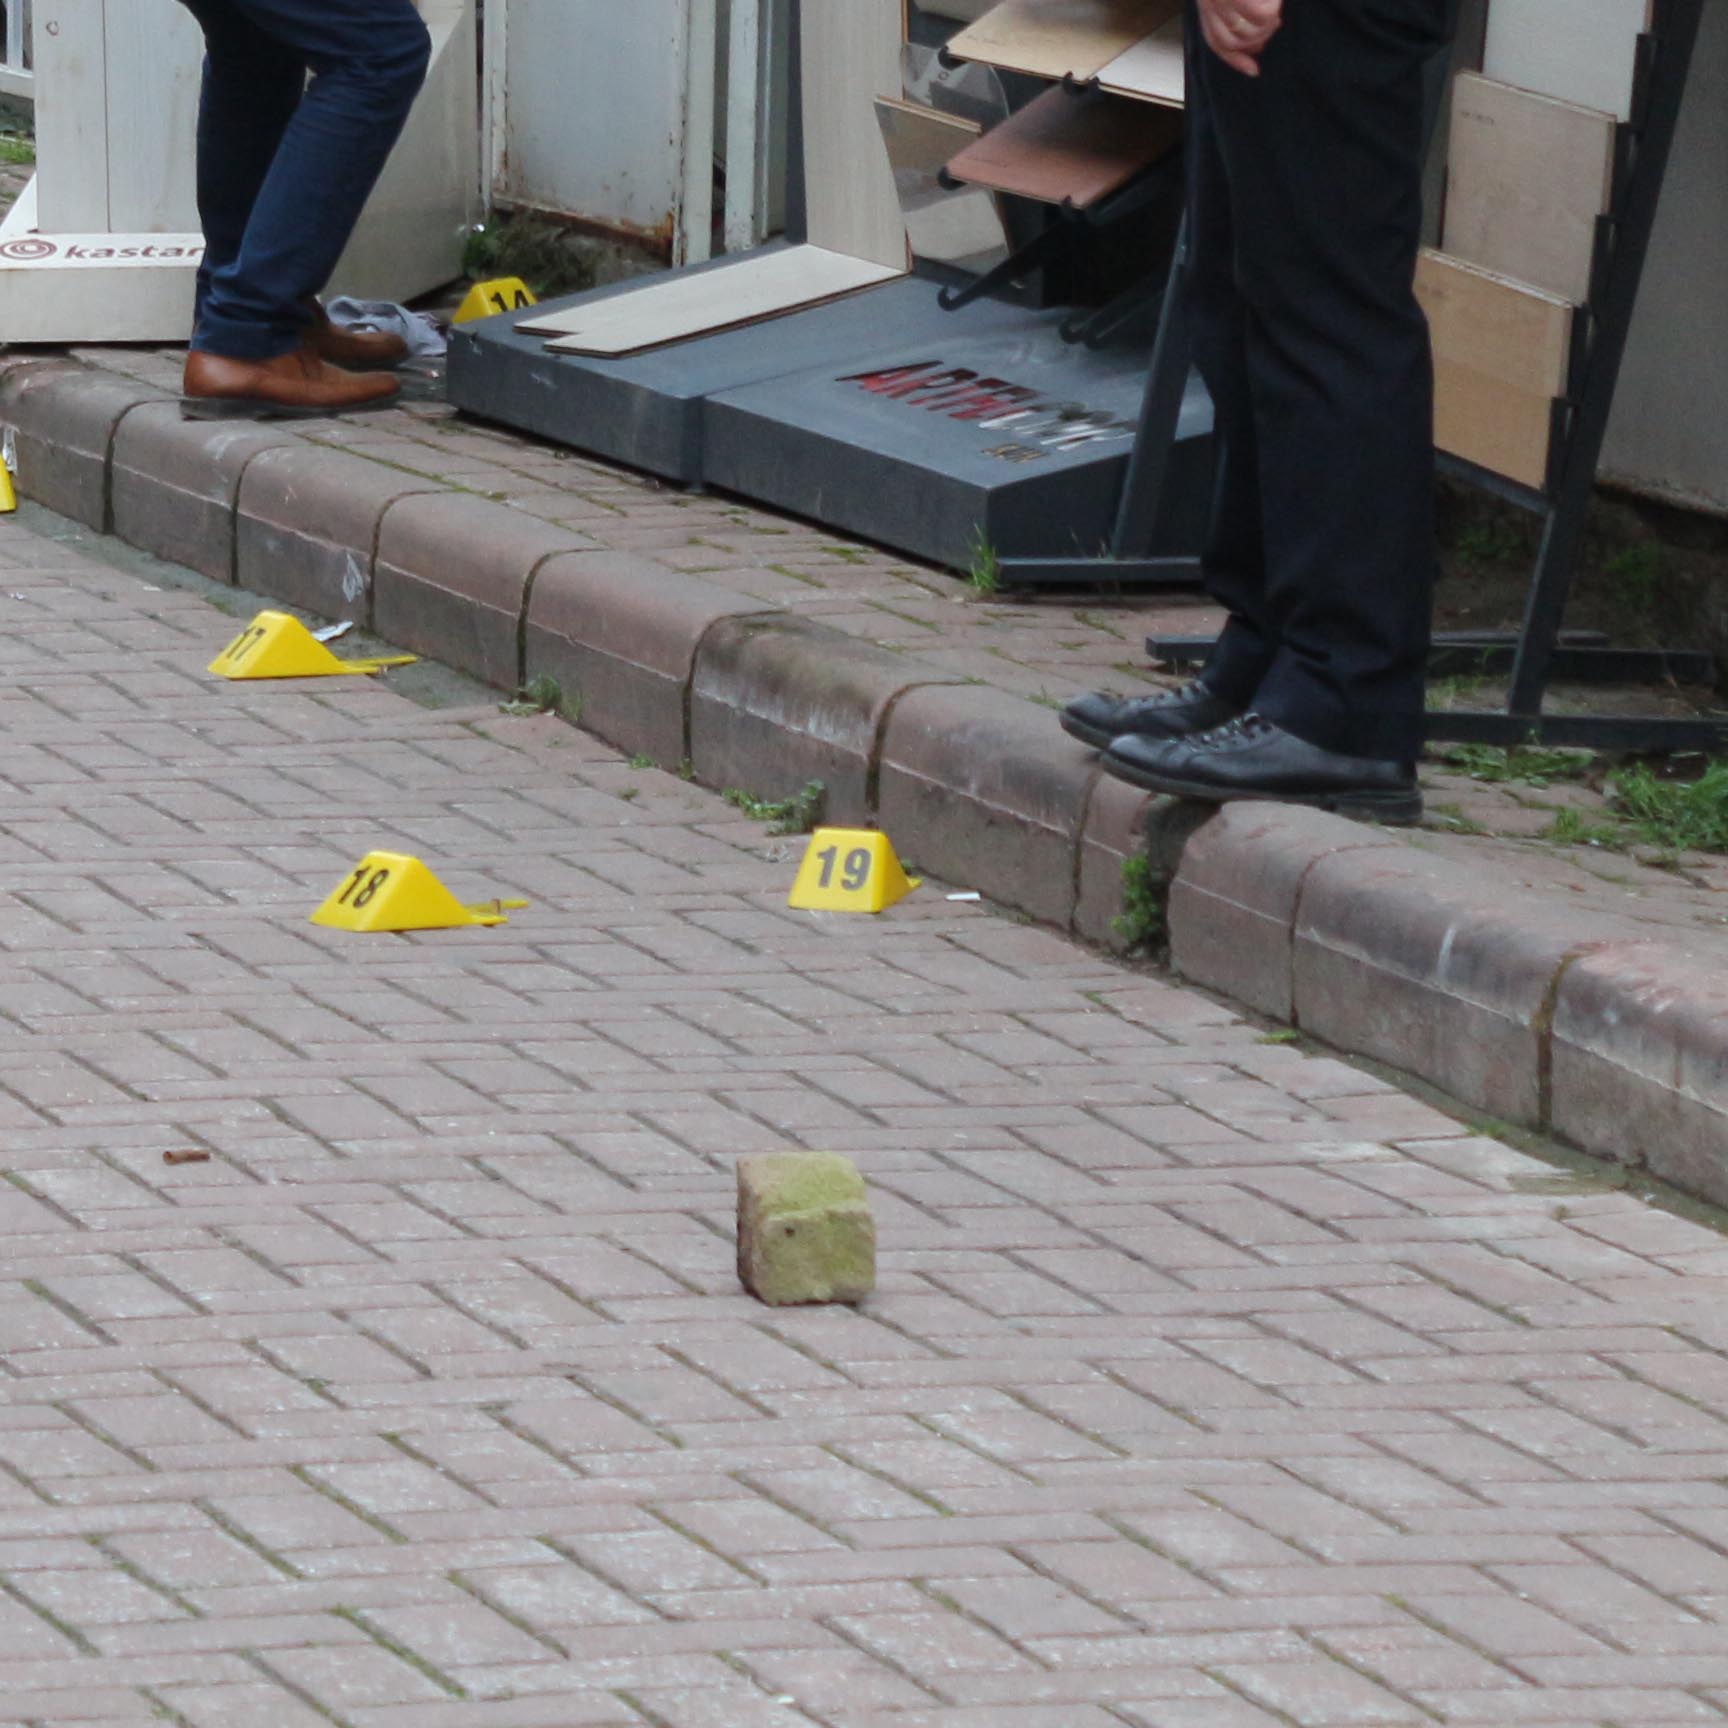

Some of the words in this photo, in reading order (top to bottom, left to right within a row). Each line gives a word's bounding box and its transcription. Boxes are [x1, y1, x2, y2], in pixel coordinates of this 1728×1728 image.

[236, 627, 267, 662] 17
[816, 845, 874, 892] 19
[337, 869, 390, 910] 18
